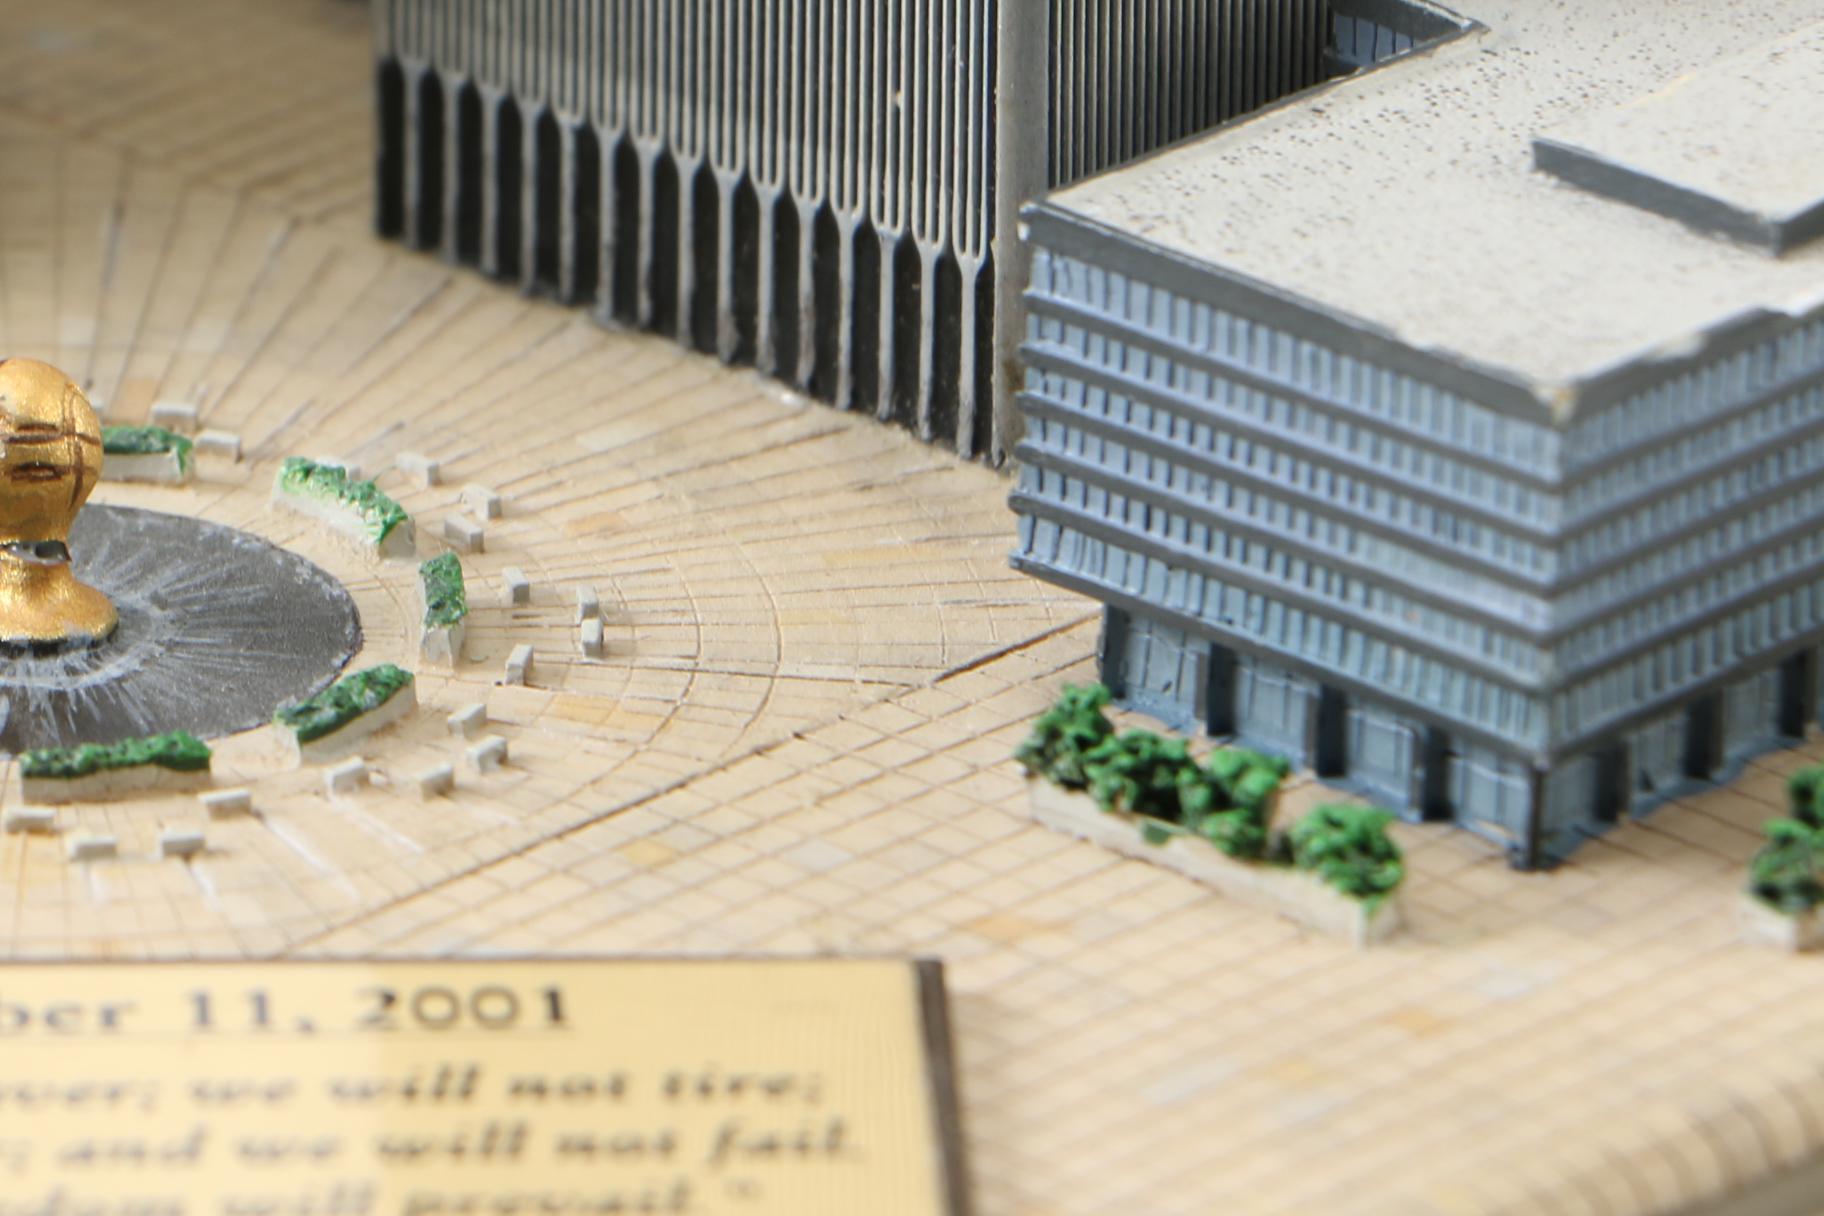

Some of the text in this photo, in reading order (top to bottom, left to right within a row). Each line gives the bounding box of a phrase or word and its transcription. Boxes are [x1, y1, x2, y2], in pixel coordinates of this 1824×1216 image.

[356, 984, 570, 1030] 2001
[188, 1078, 294, 1106] we
[330, 1066, 484, 1104] will
[508, 1070, 630, 1101] not
[54, 1124, 208, 1170] and
[236, 1136, 342, 1166] we
[374, 1120, 530, 1164] will
[556, 1128, 678, 1160] not
